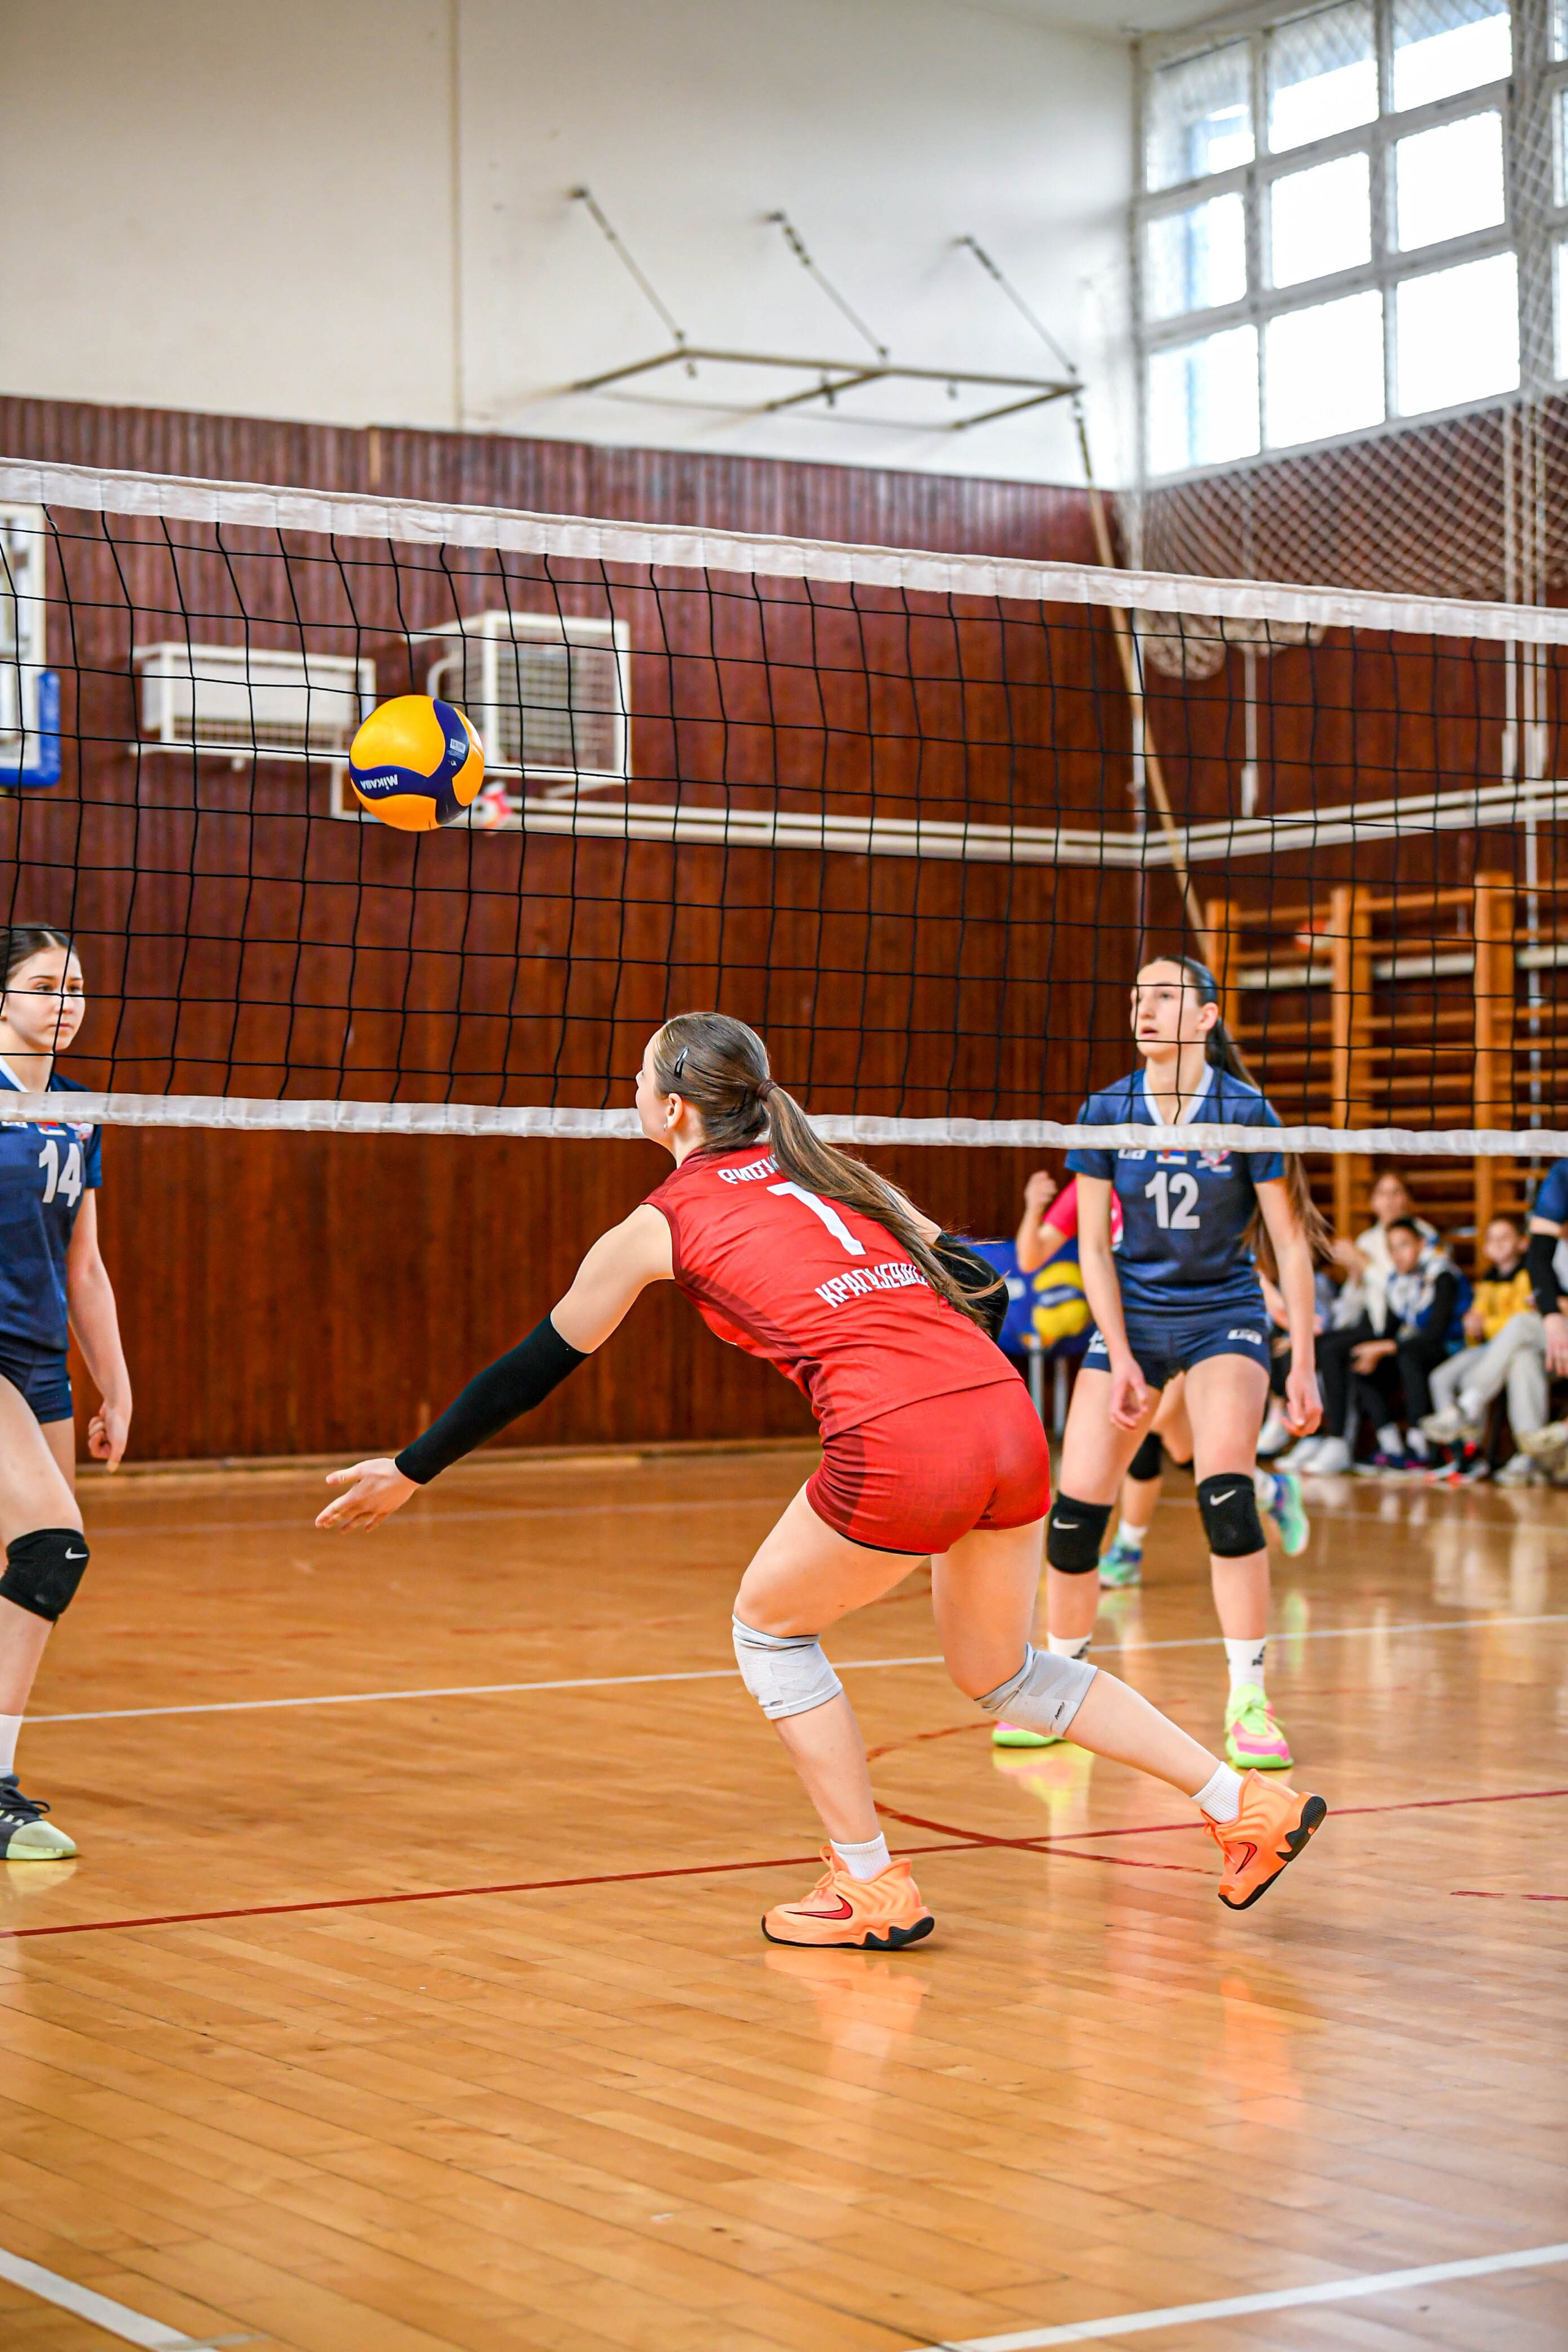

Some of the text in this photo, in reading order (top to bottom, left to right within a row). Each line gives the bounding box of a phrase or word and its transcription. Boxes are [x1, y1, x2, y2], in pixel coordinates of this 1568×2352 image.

[39, 1139, 82, 1207] 14
[717, 1154, 780, 1185] РИСТИ
[1145, 1171, 1200, 1229] 12
